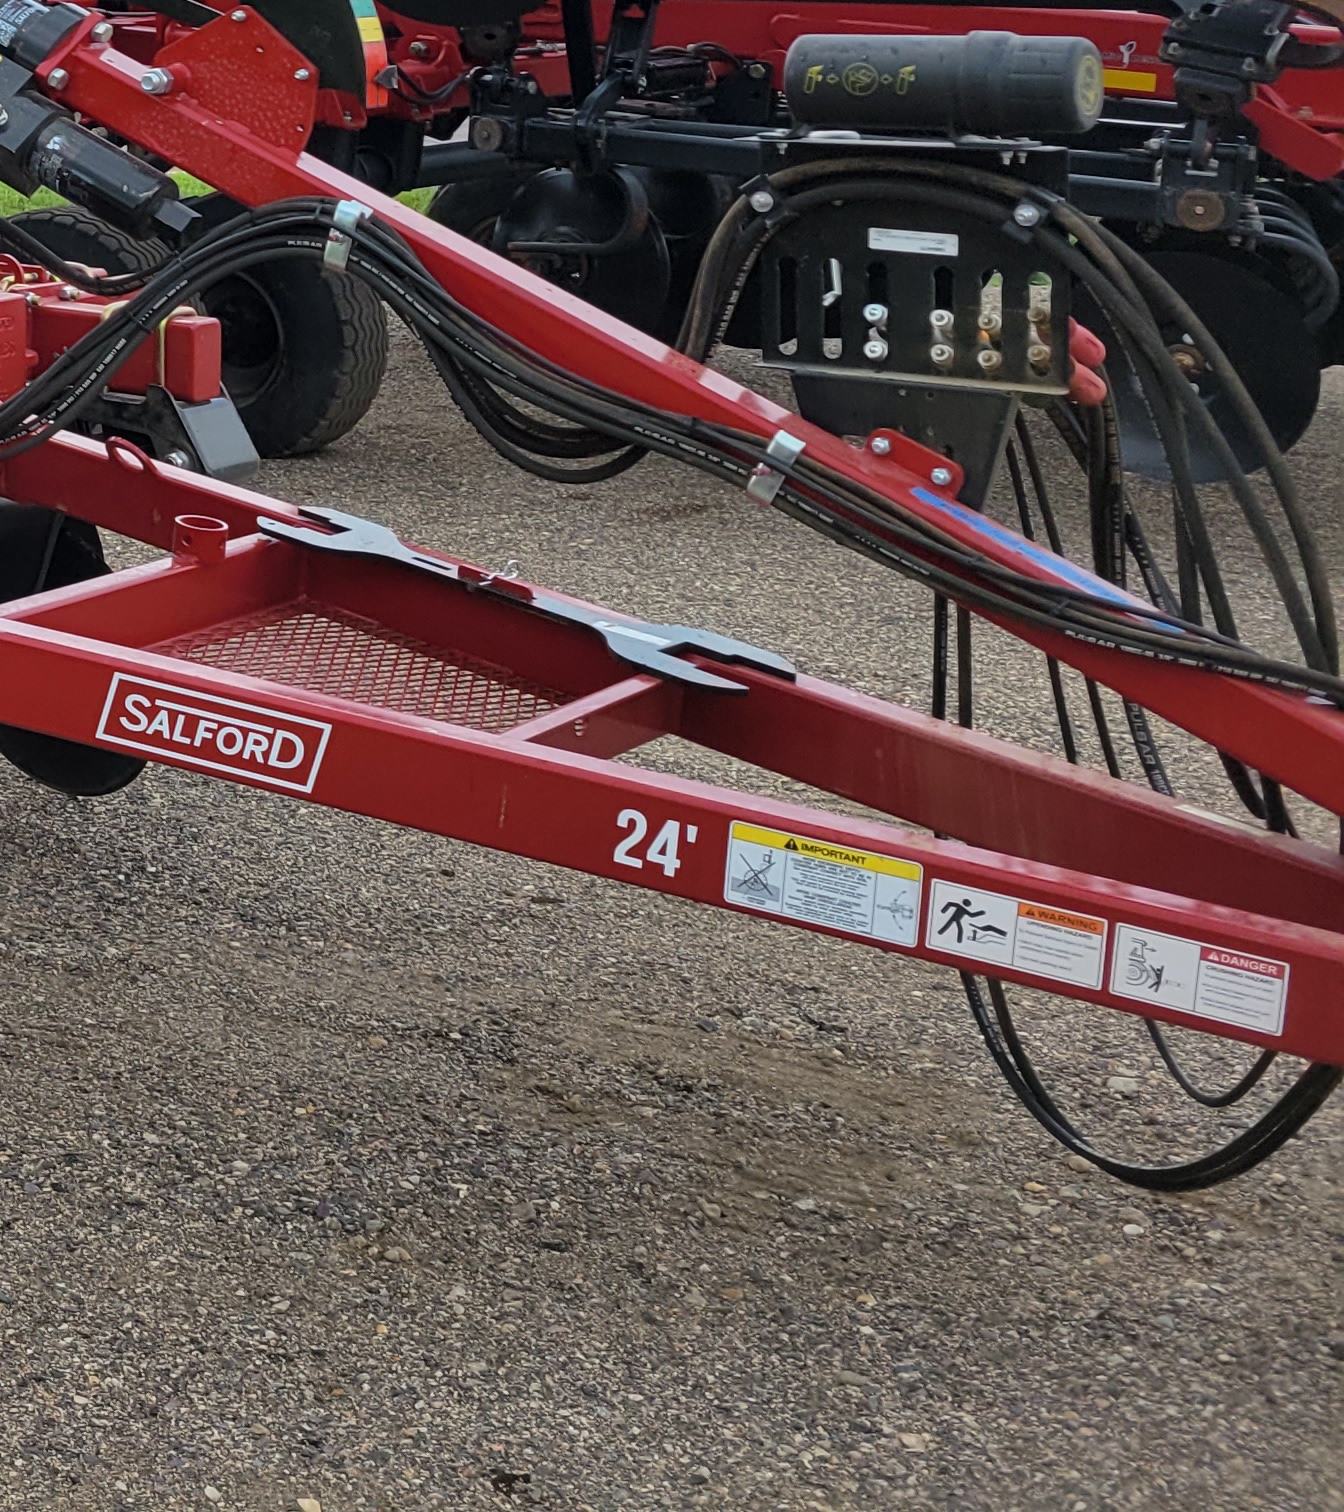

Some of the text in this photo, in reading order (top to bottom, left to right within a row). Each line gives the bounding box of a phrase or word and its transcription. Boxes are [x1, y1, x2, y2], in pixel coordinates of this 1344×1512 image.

[119, 693, 305, 770] SALFORD
[1128, 702, 1155, 765] PULSAR
[612, 808, 699, 878] 24'
[801, 842, 867, 865] IMPORTANT
[1038, 910, 1098, 931] WARNING
[1220, 953, 1278, 975] DANGER
